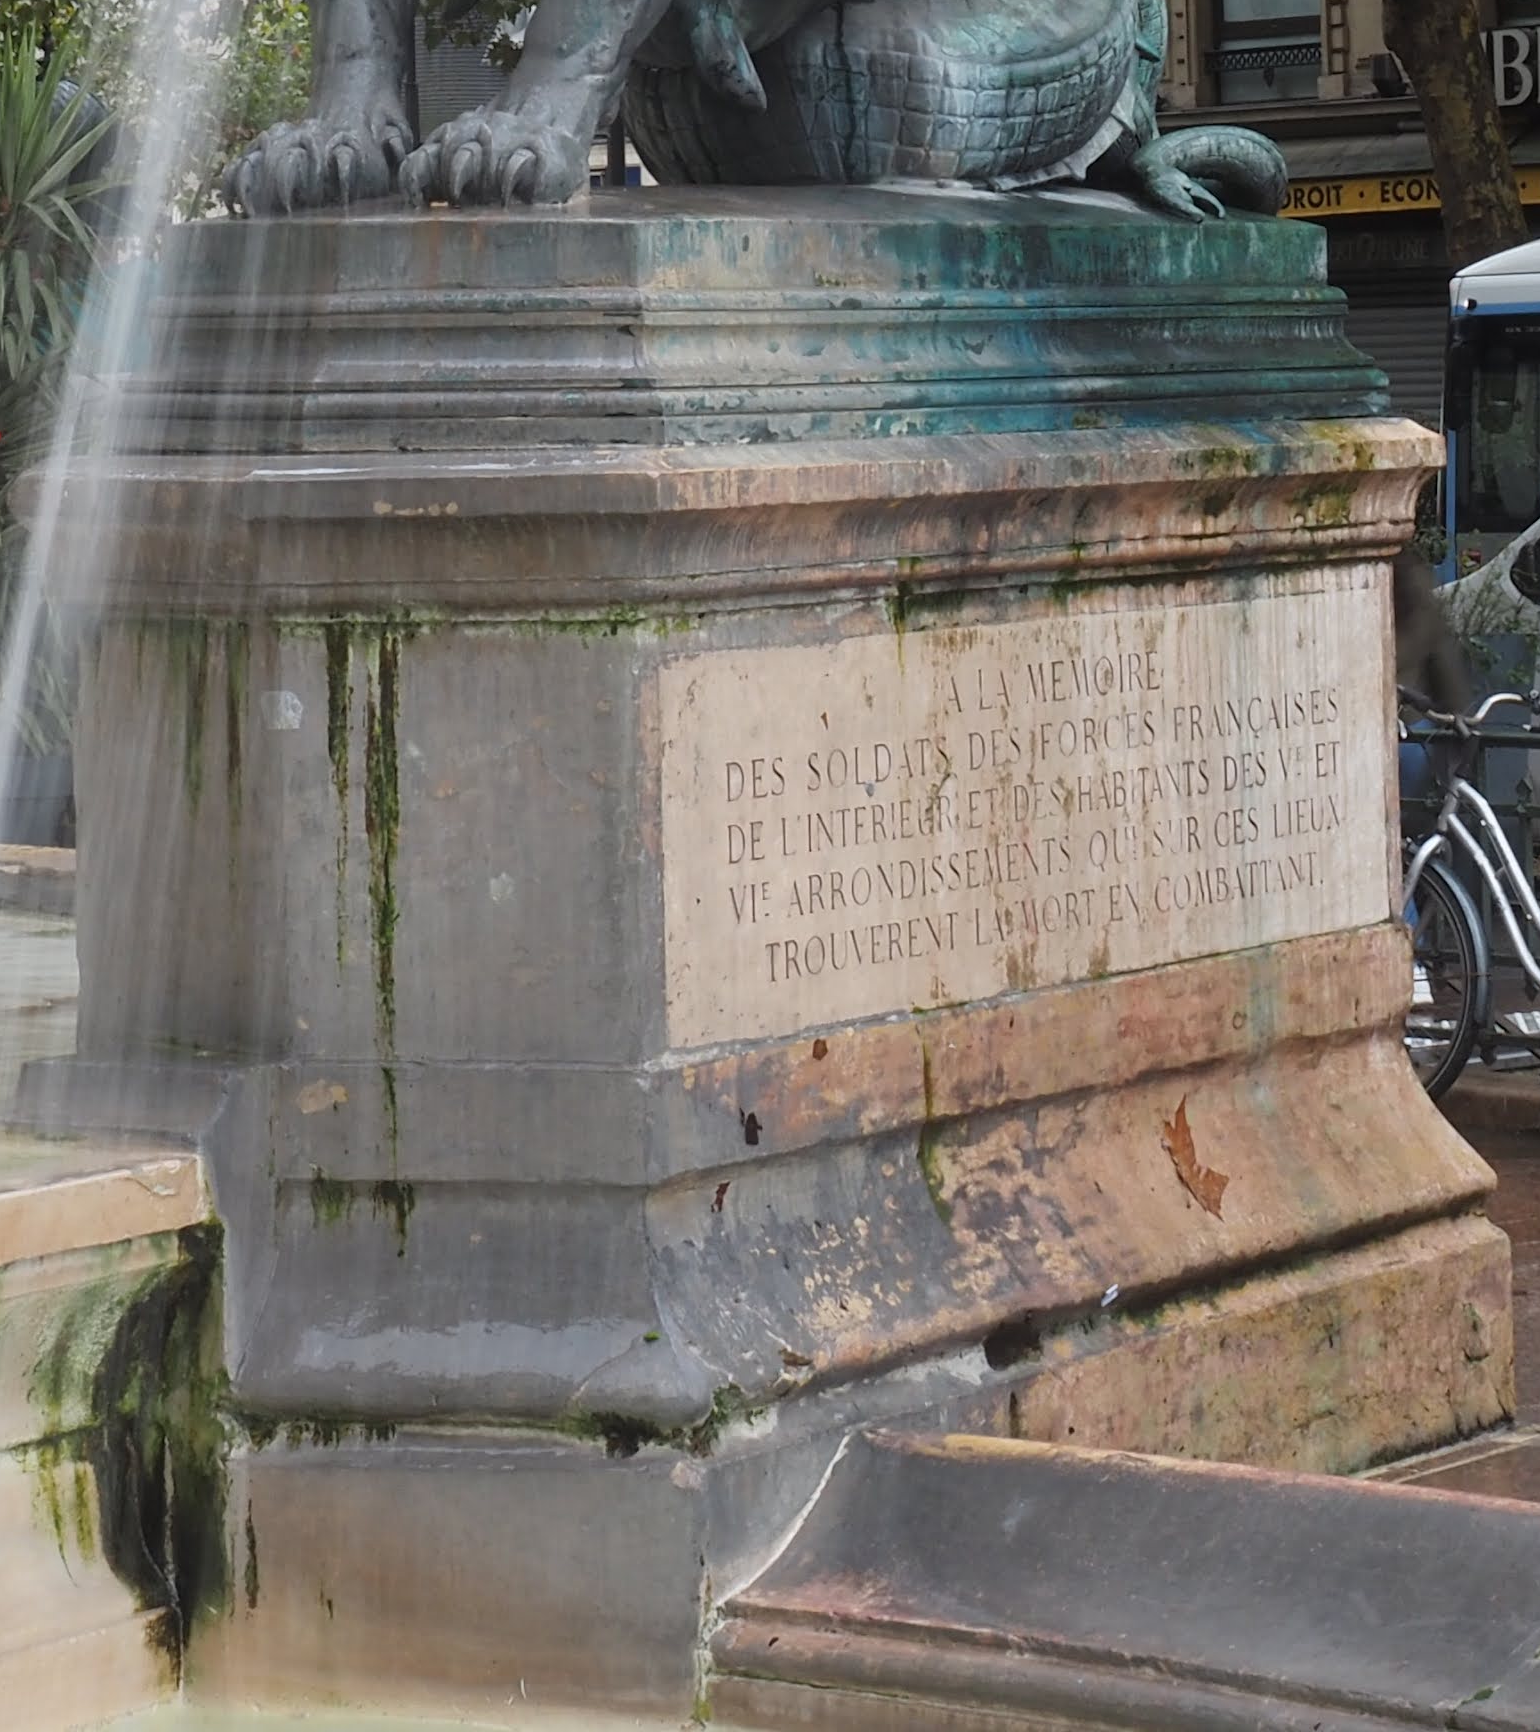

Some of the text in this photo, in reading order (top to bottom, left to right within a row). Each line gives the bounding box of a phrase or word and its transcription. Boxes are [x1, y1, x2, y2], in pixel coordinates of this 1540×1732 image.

[947, 651, 1161, 713] A LA MEMOIRE
[725, 687, 1339, 803] DES SOLDATS DES FORCES FRANÇAISES
[727, 820, 765, 865] DE
[781, 794, 953, 857] L'INTERIEUR
[968, 787, 998, 829] ET
[1013, 781, 1067, 823] DES
[1077, 758, 1210, 814] HABITANTS
[1222, 751, 1267, 792] DES
[1315, 740, 1341, 778] ET
[787, 835, 1071, 919] ARRONDISSEMENTS
[1088, 825, 1138, 872] QUI
[1152, 815, 1201, 858] SUR
[1213, 806, 1260, 848] CES
[1272, 793, 1344, 839] LIEUX
[765, 911, 959, 983] TROUVERENT
[975, 907, 1005, 947] LA
[1017, 888, 1096, 936] MORT
[1109, 880, 1142, 923] EN
